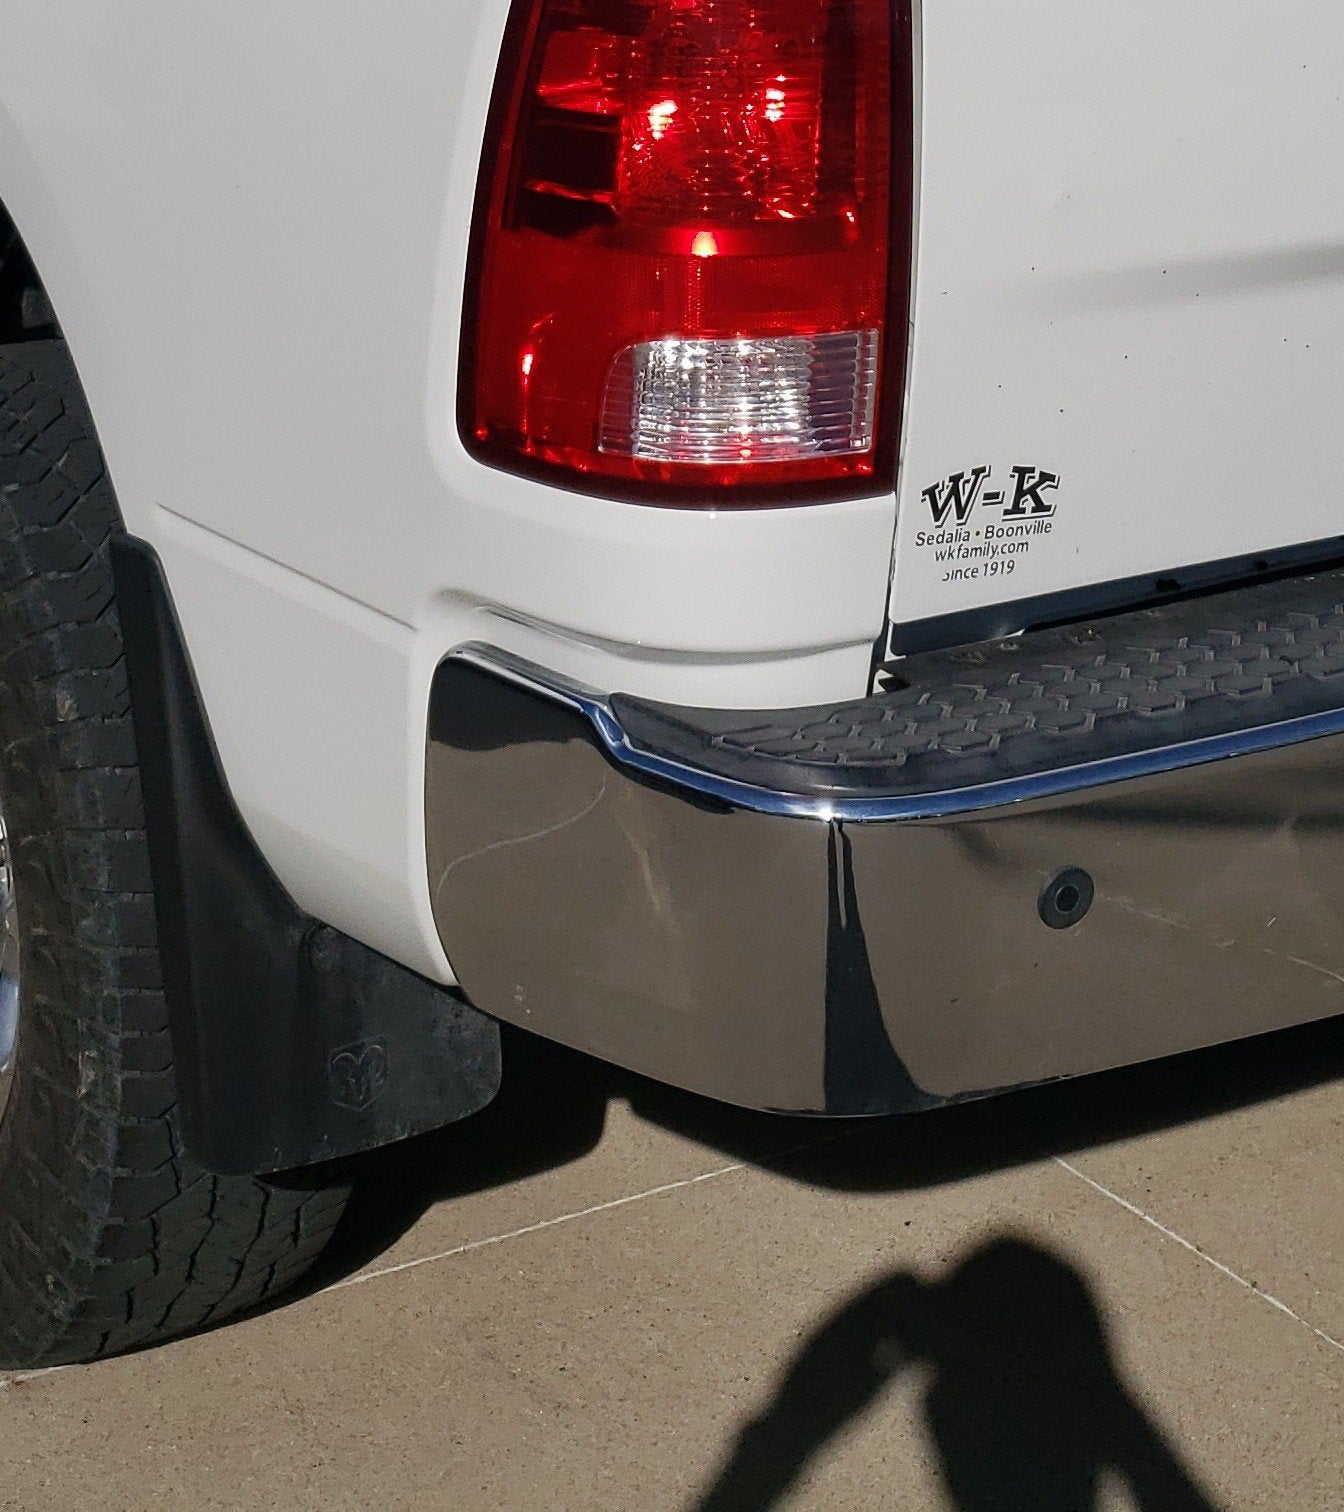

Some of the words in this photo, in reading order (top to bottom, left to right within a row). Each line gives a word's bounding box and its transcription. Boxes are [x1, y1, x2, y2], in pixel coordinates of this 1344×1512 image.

[920, 464, 1061, 529] W-K
[915, 528, 971, 547] Sedalia
[984, 520, 1053, 540] Boonville
[935, 540, 1029, 562] wkfamily.com
[983, 559, 1015, 577] 1919
